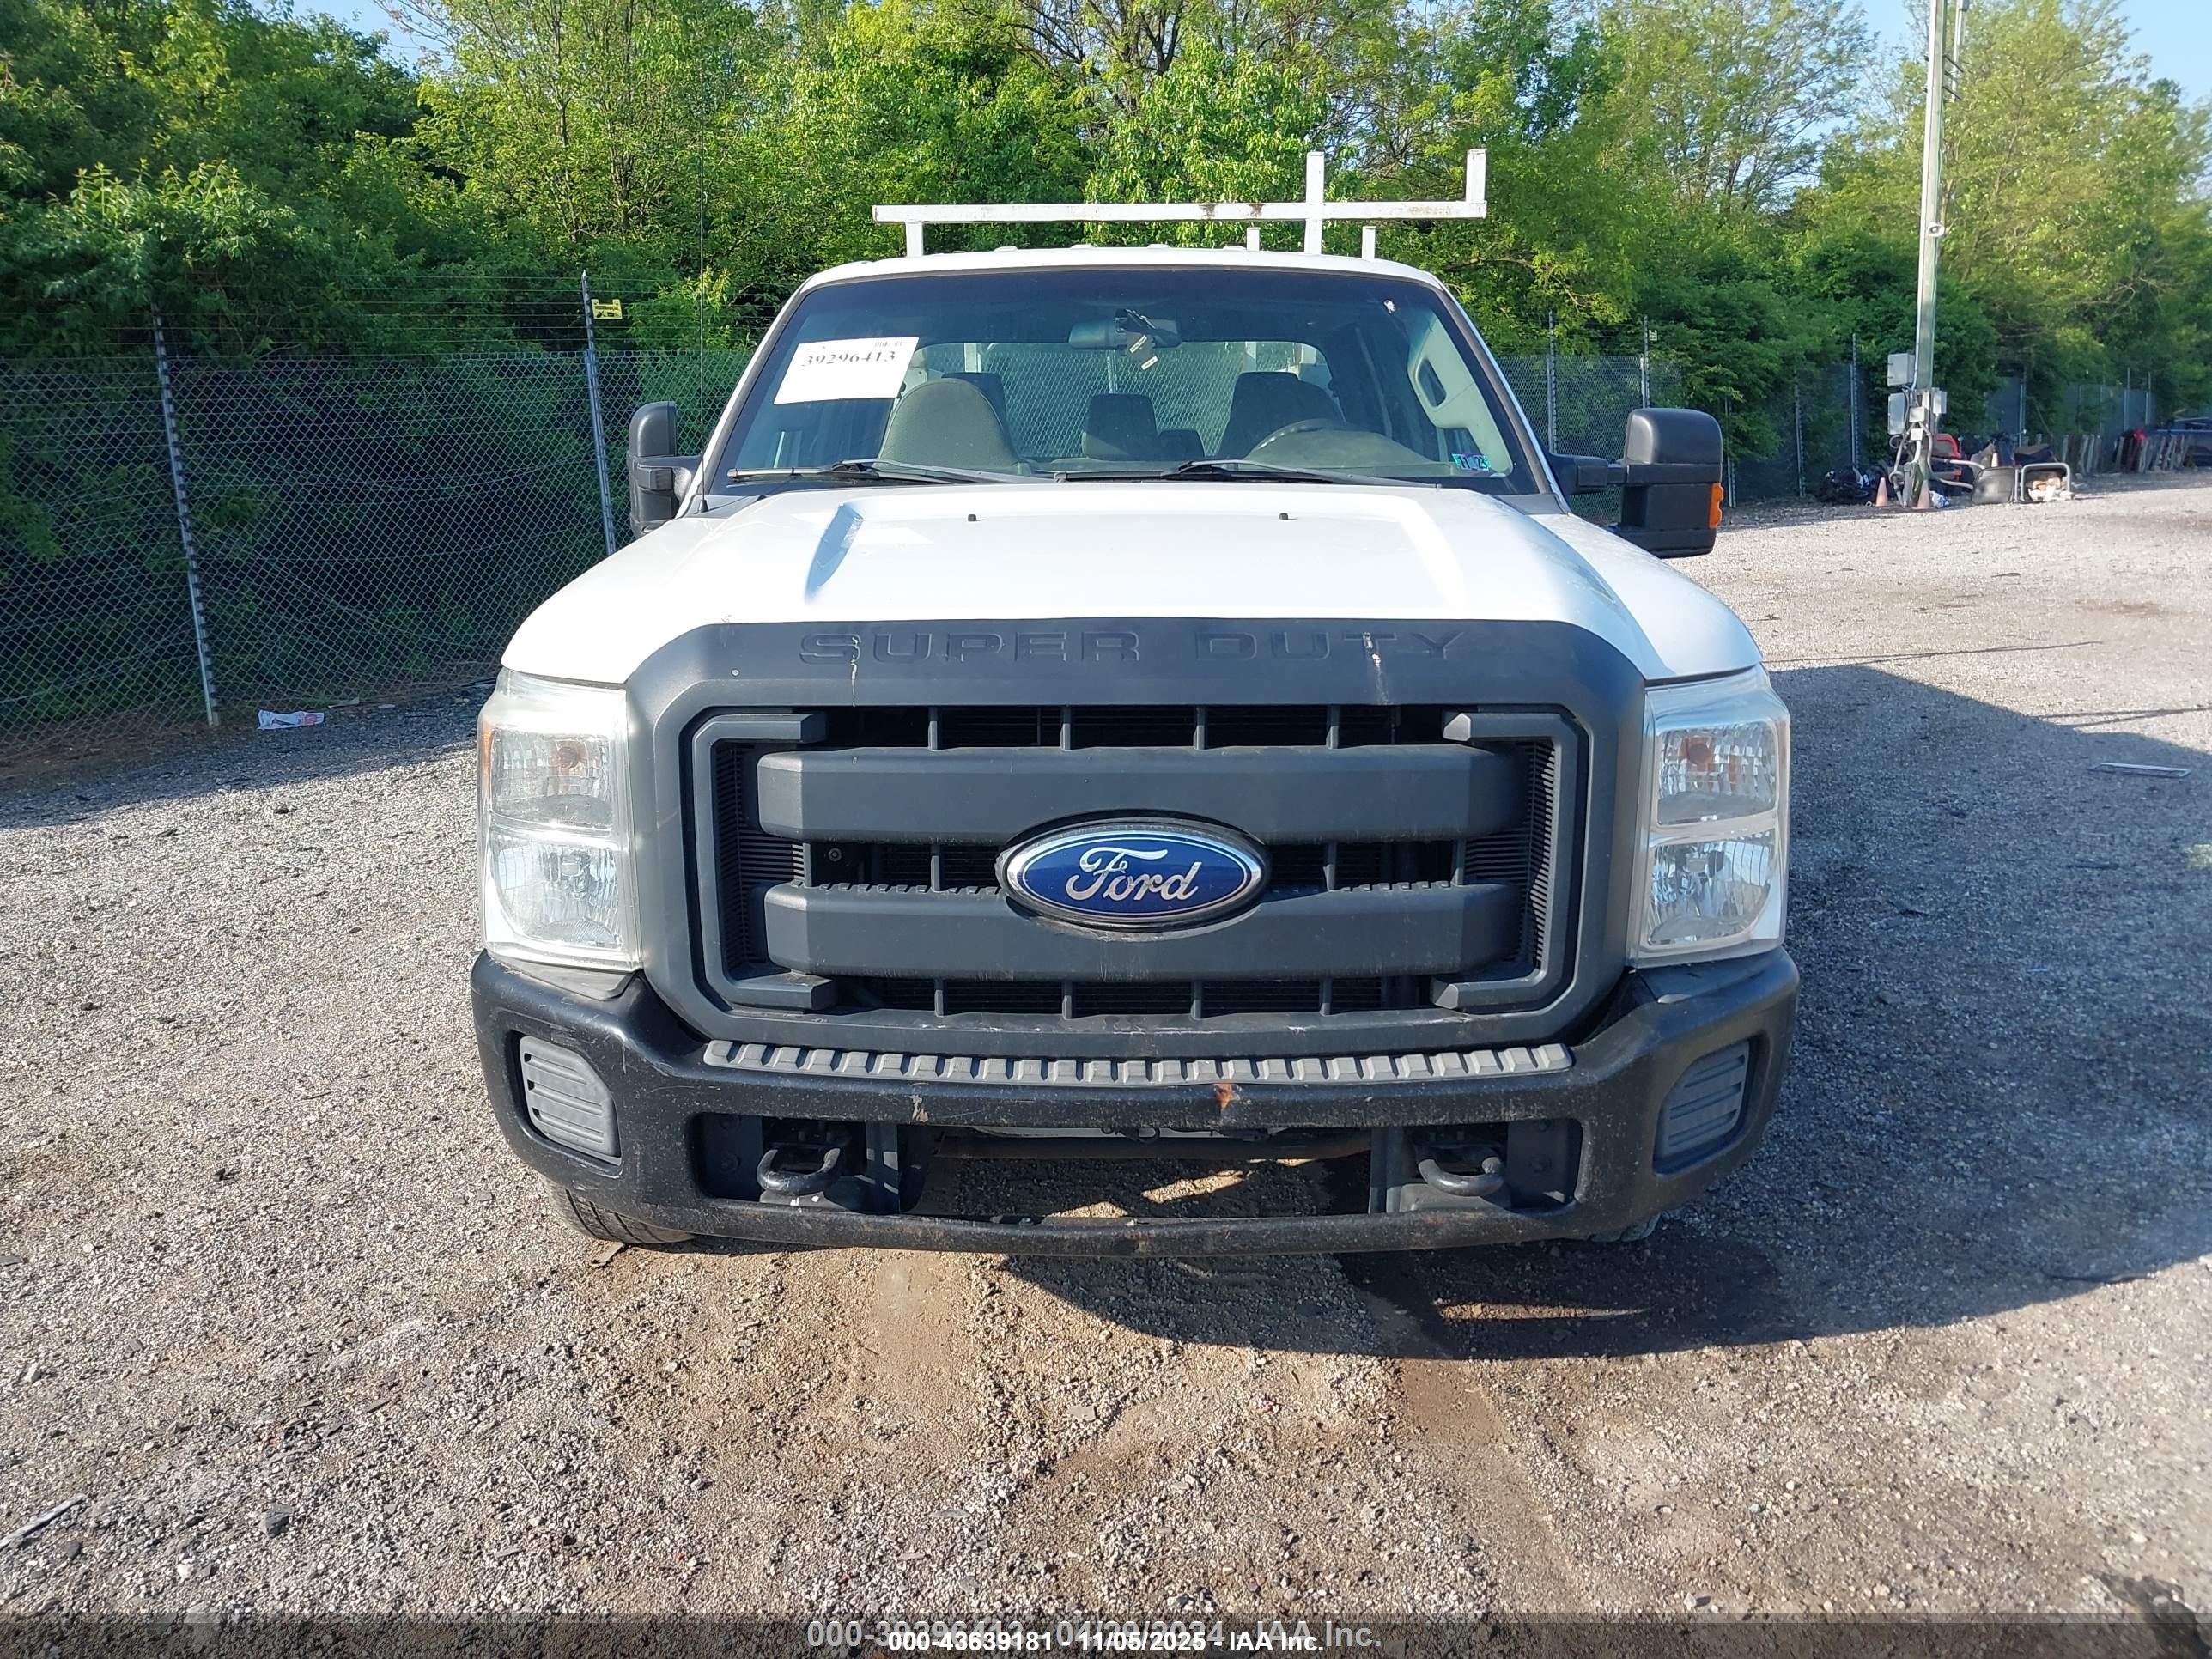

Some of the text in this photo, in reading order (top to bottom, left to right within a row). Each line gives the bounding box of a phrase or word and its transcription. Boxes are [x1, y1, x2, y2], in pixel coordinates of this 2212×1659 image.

[799, 631, 1464, 665] SUPER DUTY
[1066, 847, 1202, 901] Ford
